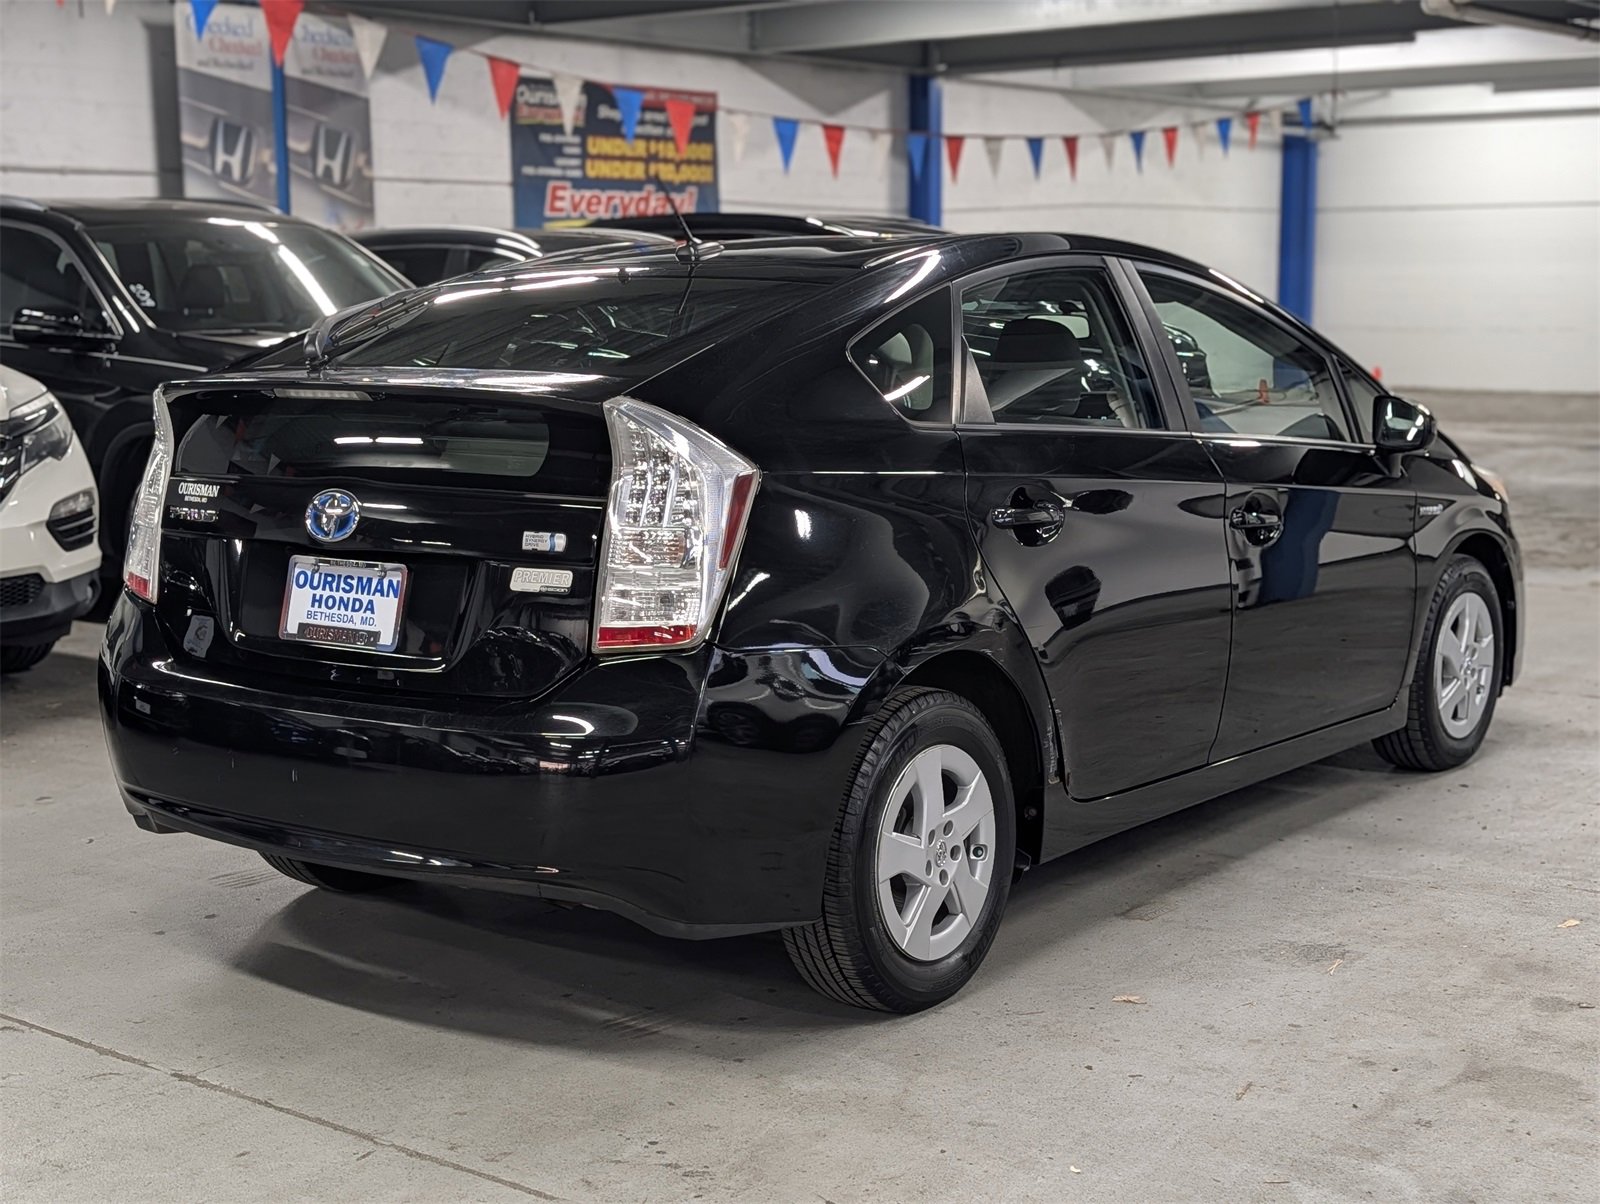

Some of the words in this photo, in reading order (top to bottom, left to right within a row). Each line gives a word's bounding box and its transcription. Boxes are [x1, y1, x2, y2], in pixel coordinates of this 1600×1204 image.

[586, 135, 647, 157] UNDER
[585, 158, 646, 180] UNDER
[545, 182, 698, 217] Everyday!
[178, 482, 220, 497] OURISMAN
[295, 570, 400, 598] OURISMAN
[514, 569, 570, 585] PREMIER
[310, 593, 375, 614] HONDA
[306, 610, 357, 626] BETHESDA,
[360, 615, 377, 627] MD.
